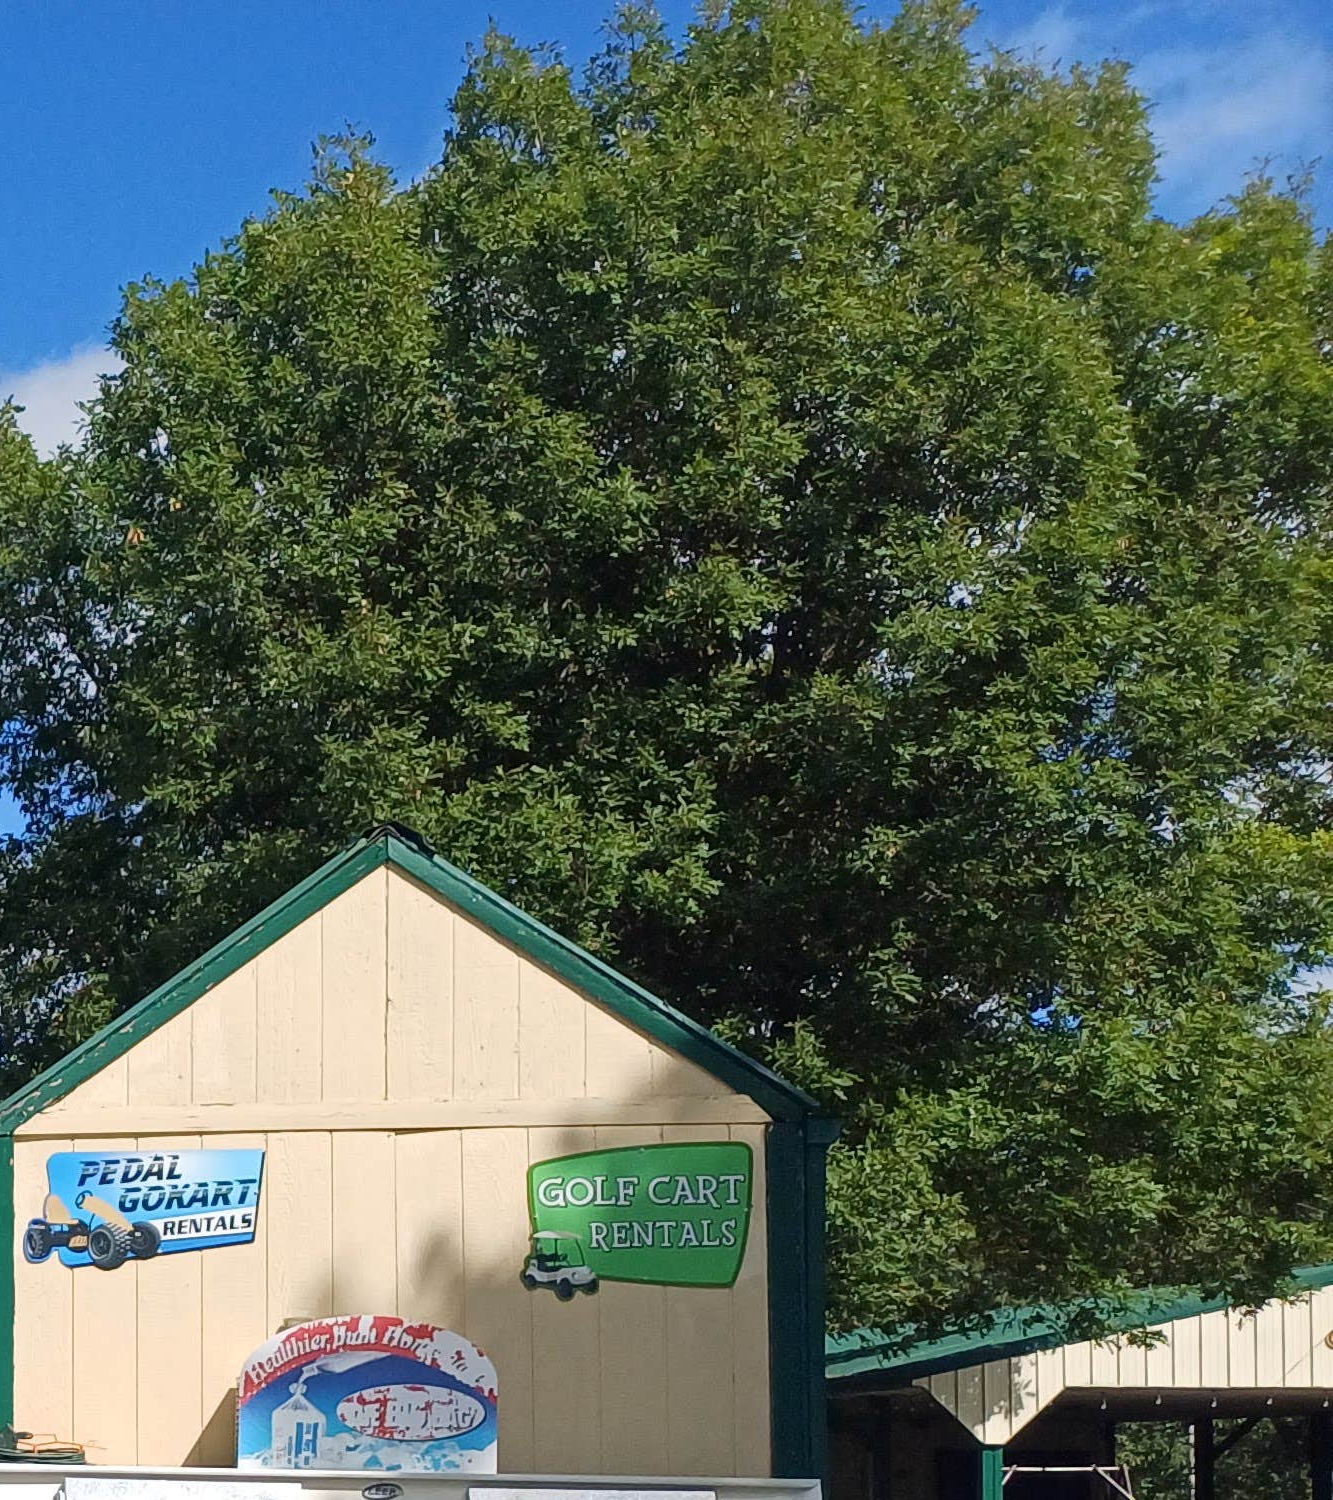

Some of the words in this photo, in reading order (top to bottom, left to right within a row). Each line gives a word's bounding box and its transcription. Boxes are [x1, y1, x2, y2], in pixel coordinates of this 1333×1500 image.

[76, 1153, 183, 1187] PEDAL
[118, 1178, 258, 1213] GOKART
[538, 1176, 638, 1207] GOLF
[648, 1175, 745, 1208] CART
[162, 1213, 253, 1237] RENTALS
[589, 1219, 737, 1252] RENTALS
